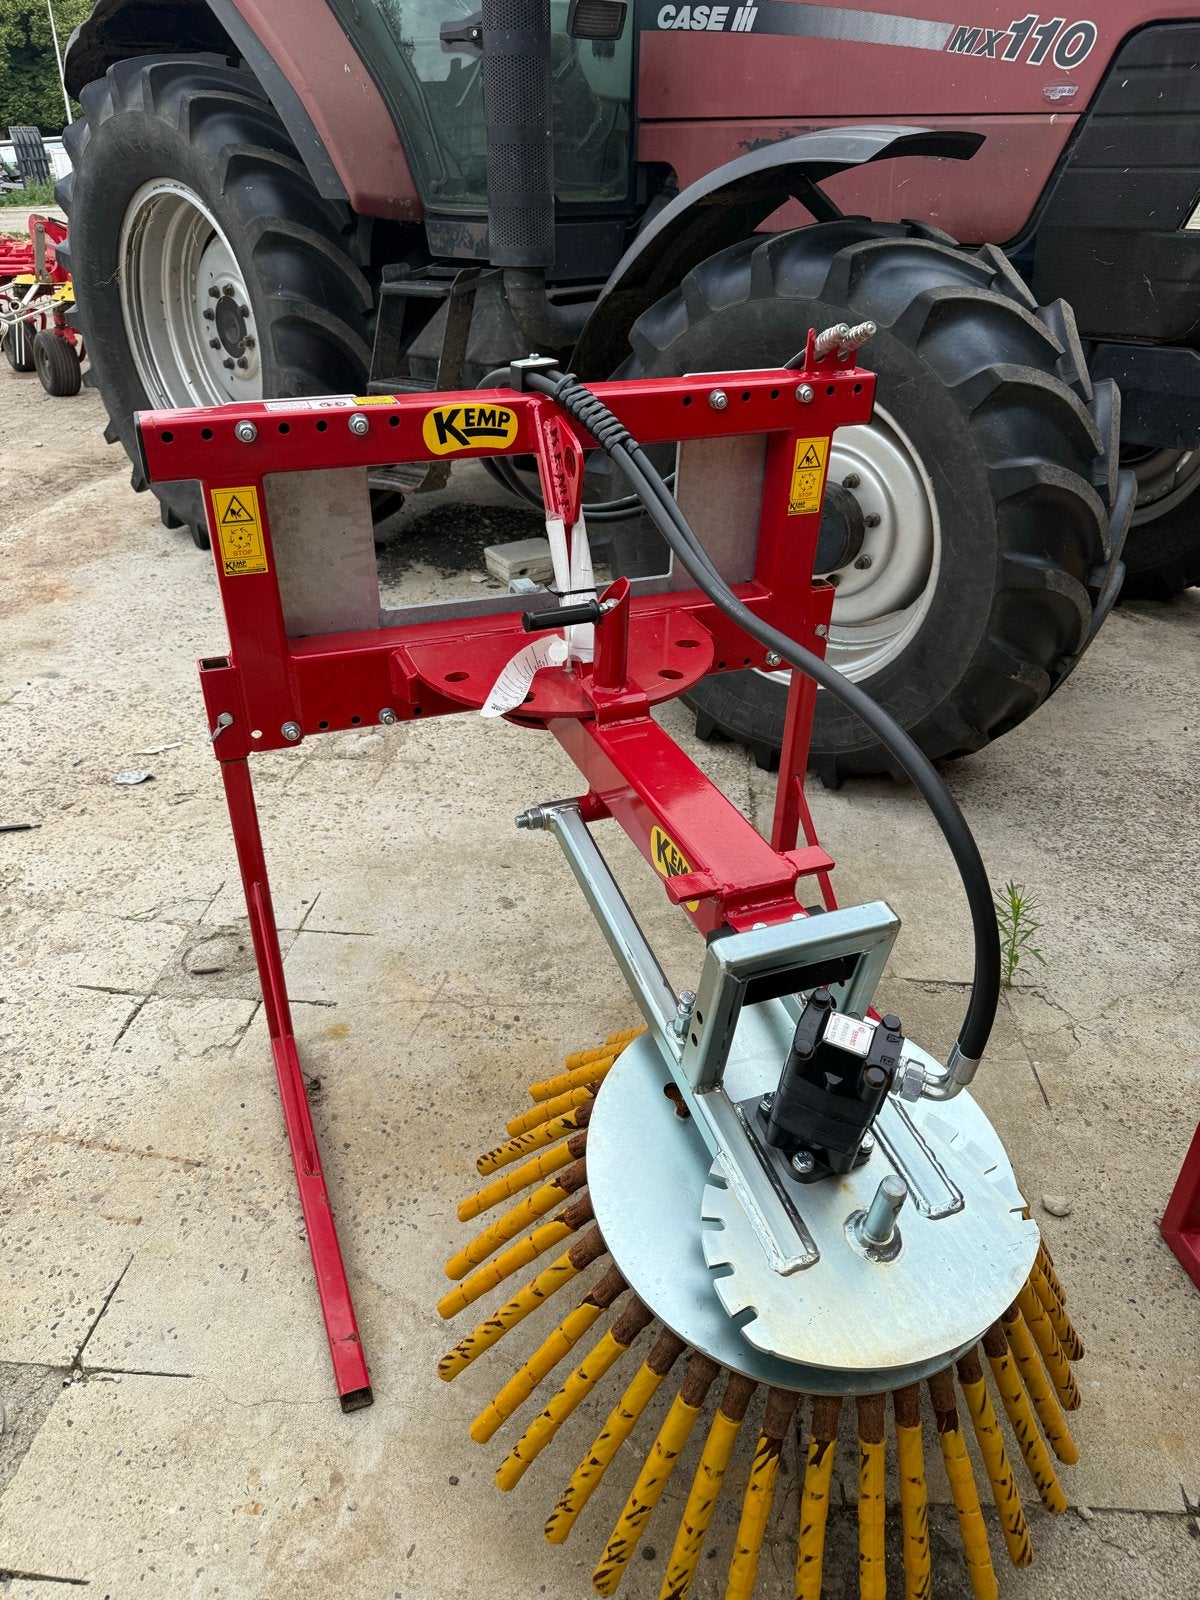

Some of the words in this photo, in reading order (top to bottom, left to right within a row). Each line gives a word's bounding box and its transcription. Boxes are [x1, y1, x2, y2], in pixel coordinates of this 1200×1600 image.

[657, 4, 730, 31] CASE
[947, 13, 1098, 70] MX110
[433, 407, 511, 447] KEMP
[225, 560, 247, 571] KEMP
[233, 549, 253, 557] STOP
[656, 829, 689, 878] KEM
